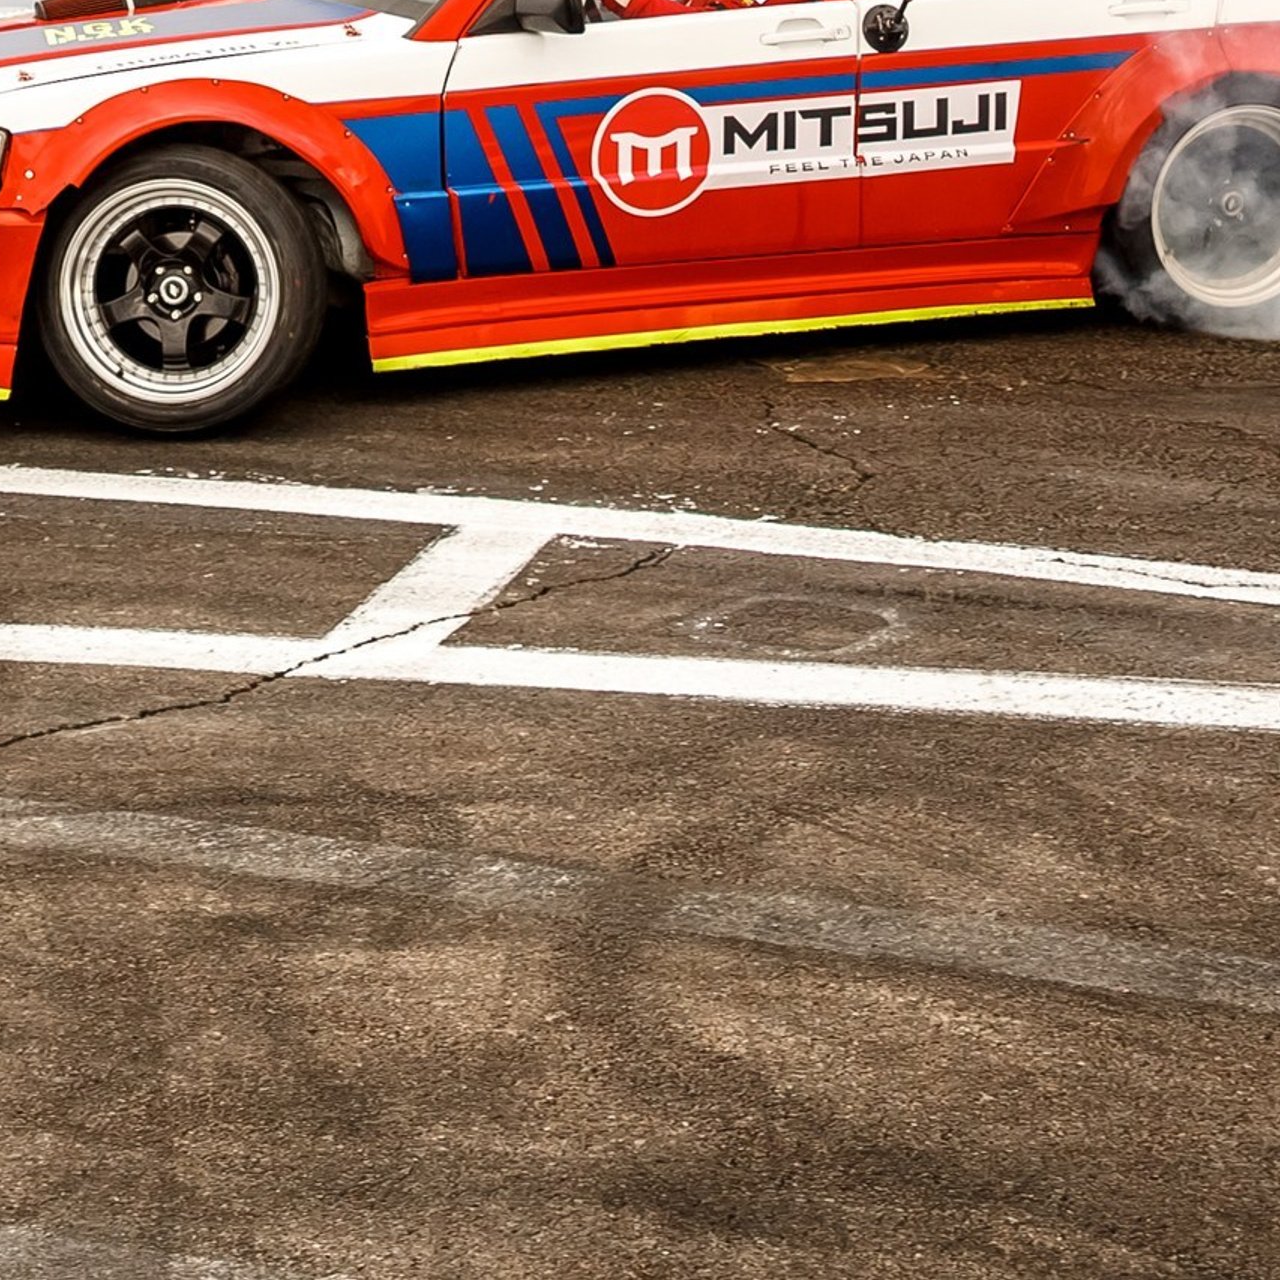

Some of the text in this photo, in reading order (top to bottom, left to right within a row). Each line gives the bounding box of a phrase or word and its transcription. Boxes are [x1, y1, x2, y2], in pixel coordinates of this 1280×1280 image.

[723, 92, 1007, 155] MITSUJI
[769, 148, 970, 175] FEEL THE JAPAN
